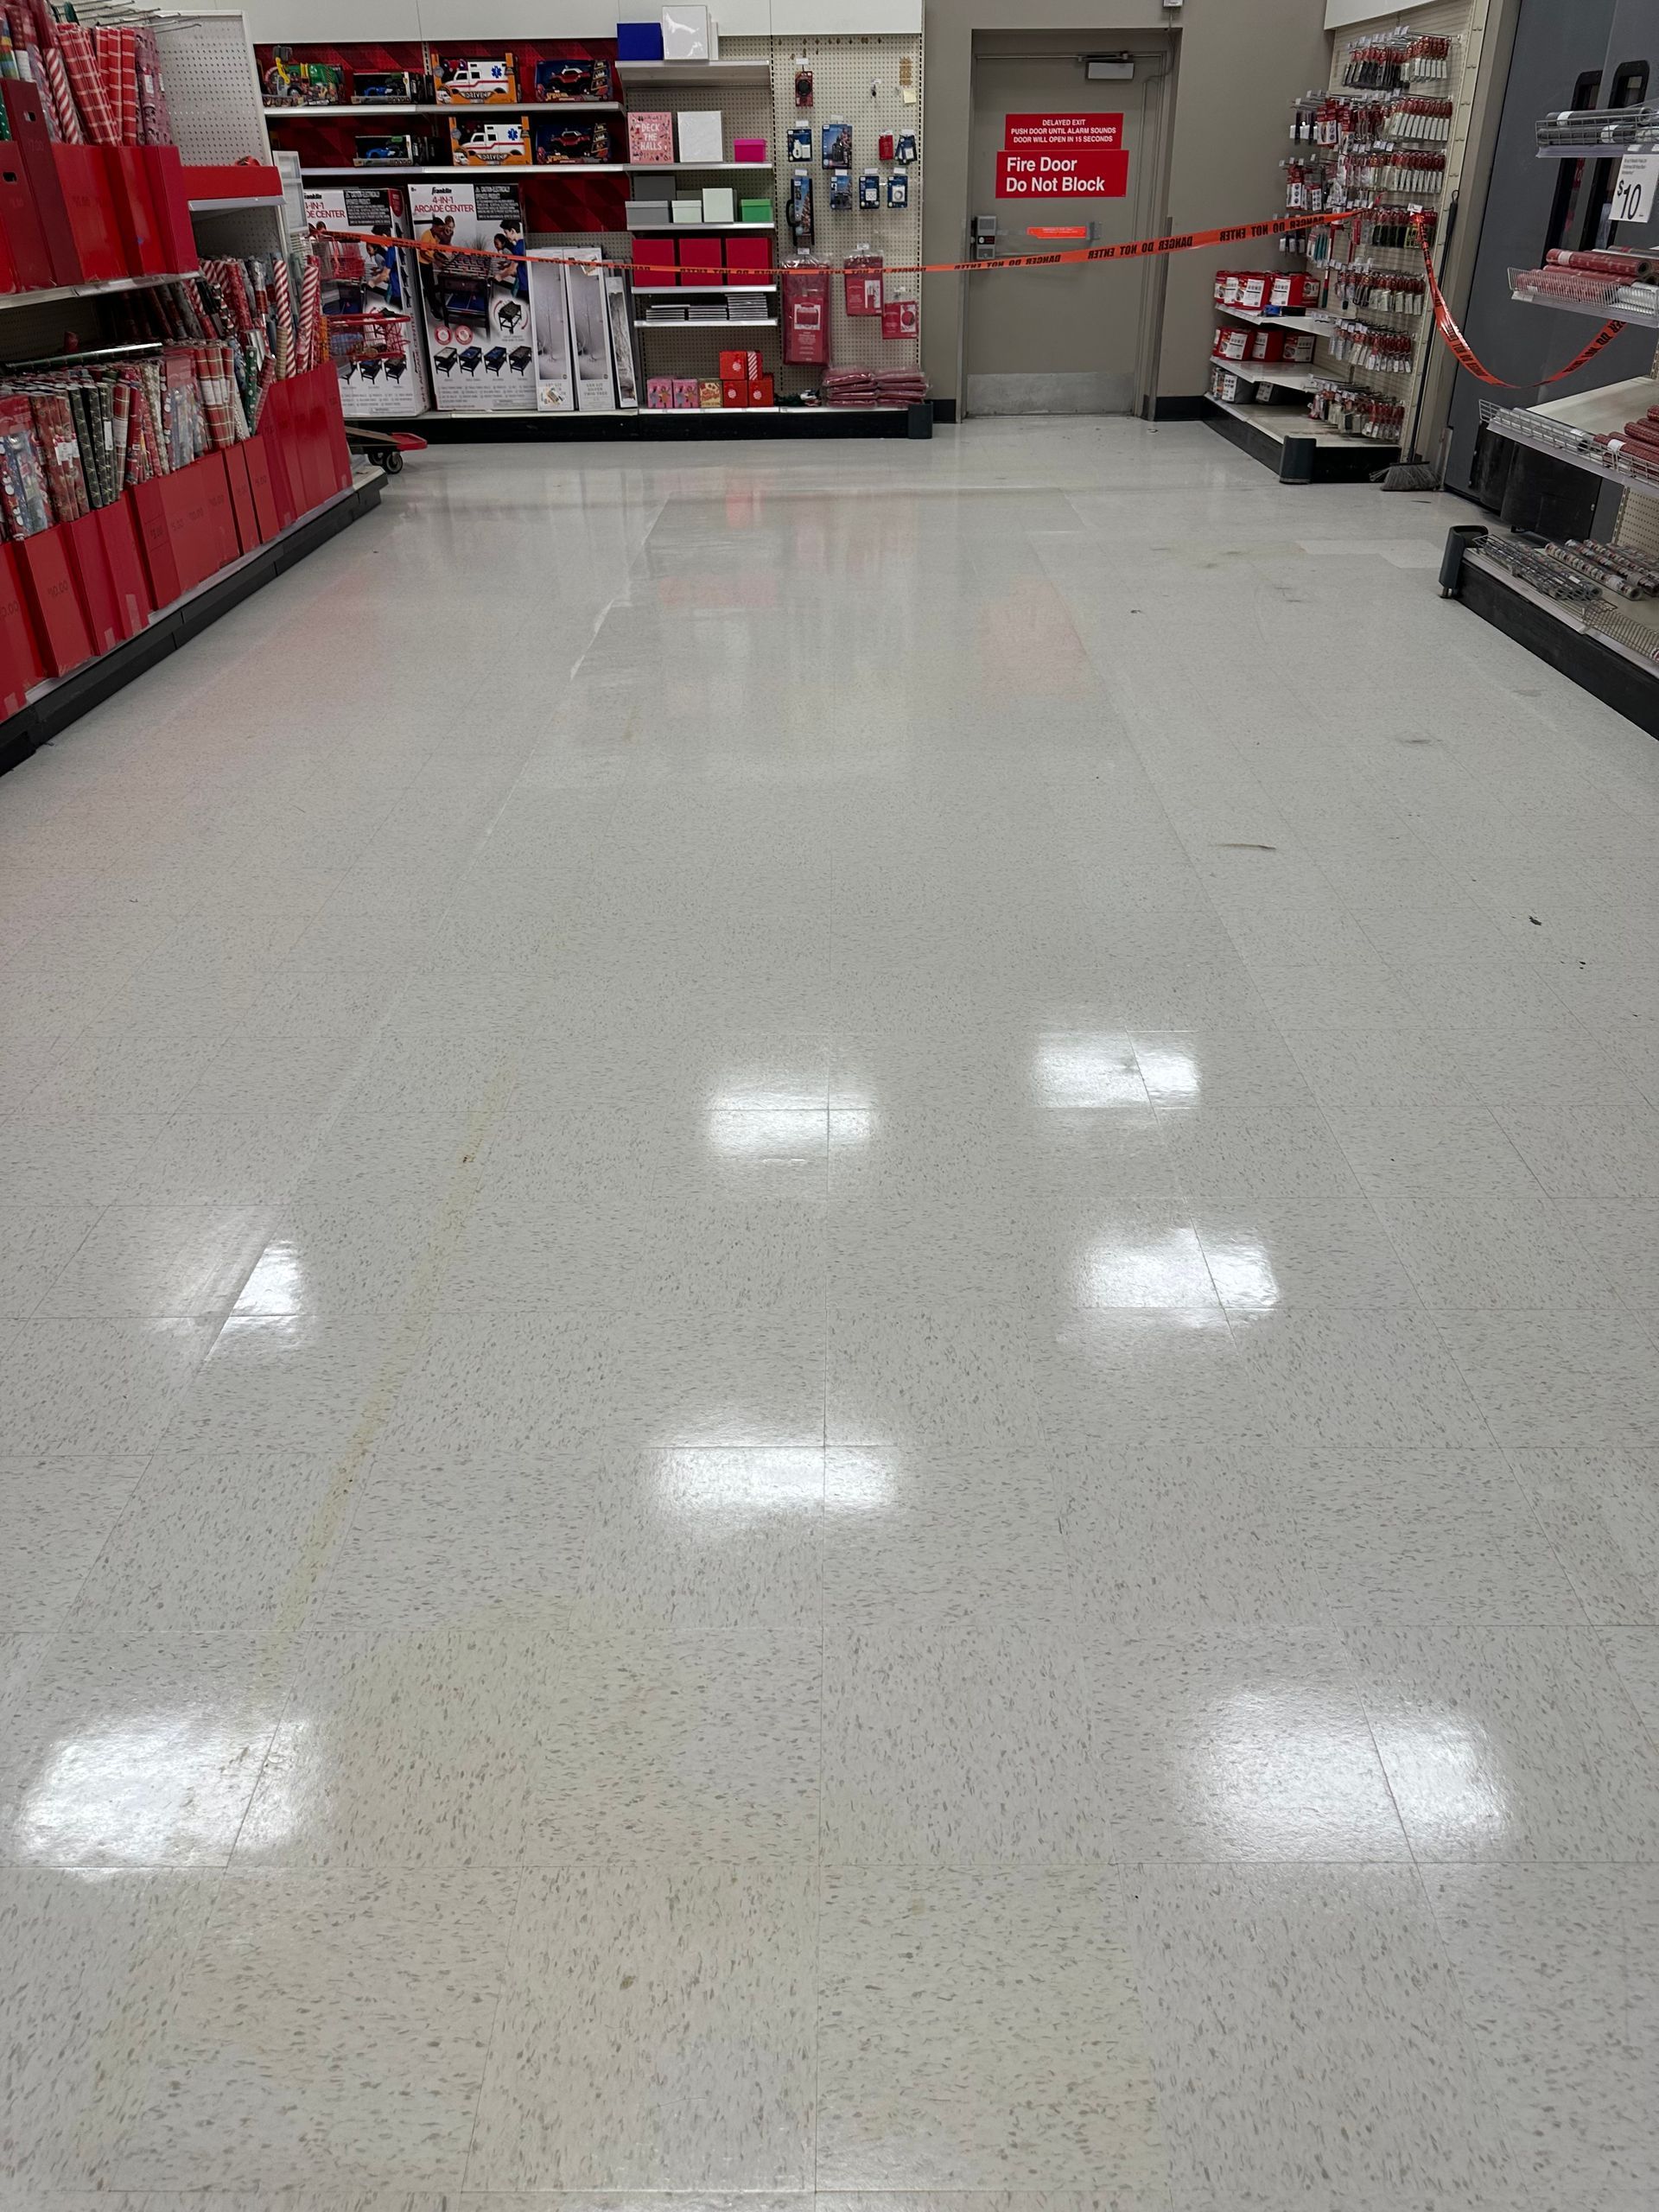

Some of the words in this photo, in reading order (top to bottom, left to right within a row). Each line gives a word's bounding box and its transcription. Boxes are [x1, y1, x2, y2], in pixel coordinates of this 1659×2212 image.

[641, 123, 660, 131] DECK
[640, 142, 663, 150] HALLS
[1007, 157, 1036, 172] Fire
[1040, 156, 1078, 172] Door
[1006, 177, 1027, 192] Do
[1031, 177, 1058, 192] Not
[1061, 176, 1105, 192] Block
[1618, 179, 1642, 220] $10
[414, 204, 444, 213] ARCADE
[444, 204, 475, 213] CENTER
